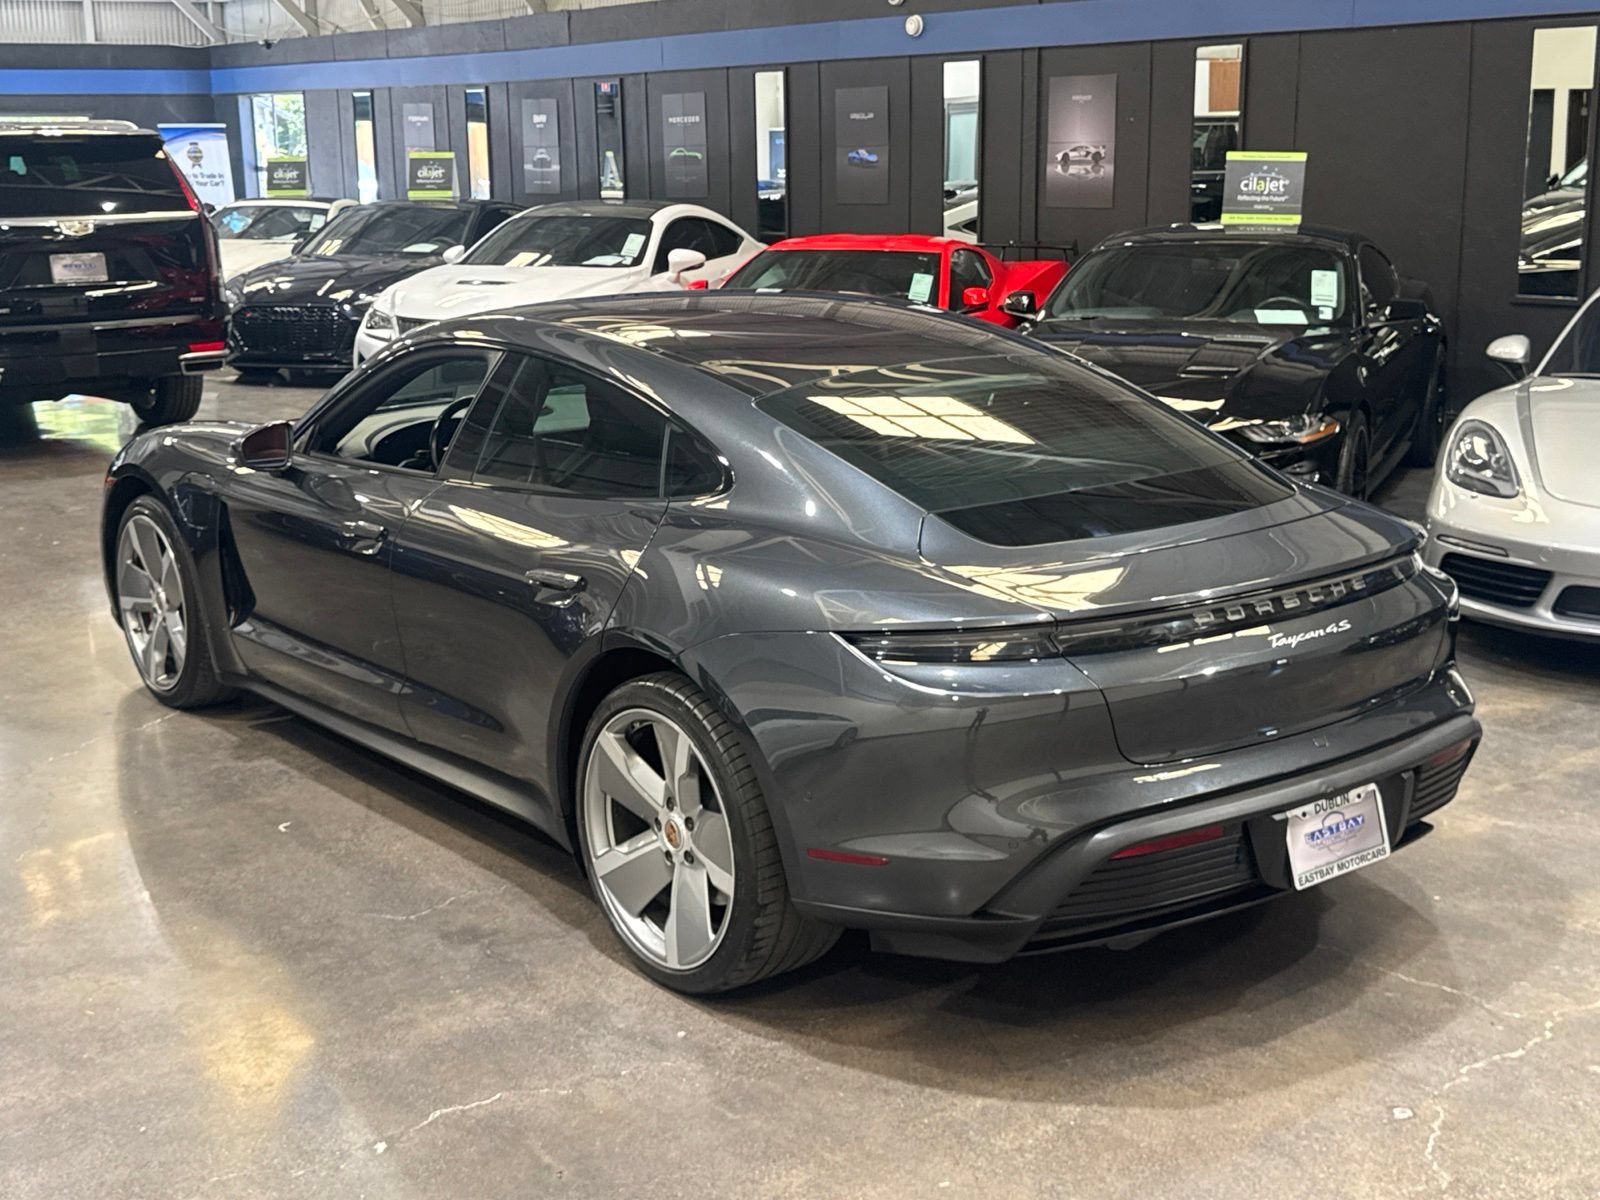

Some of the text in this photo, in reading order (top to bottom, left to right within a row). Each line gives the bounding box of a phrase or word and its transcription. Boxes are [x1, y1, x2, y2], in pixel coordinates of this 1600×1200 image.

[1240, 177, 1286, 195] cilajet
[1194, 576, 1367, 627] PORSCHE
[1314, 792, 1350, 815] DUBLIN
[1298, 846, 1388, 887] EASTBAY MOTORCARS
